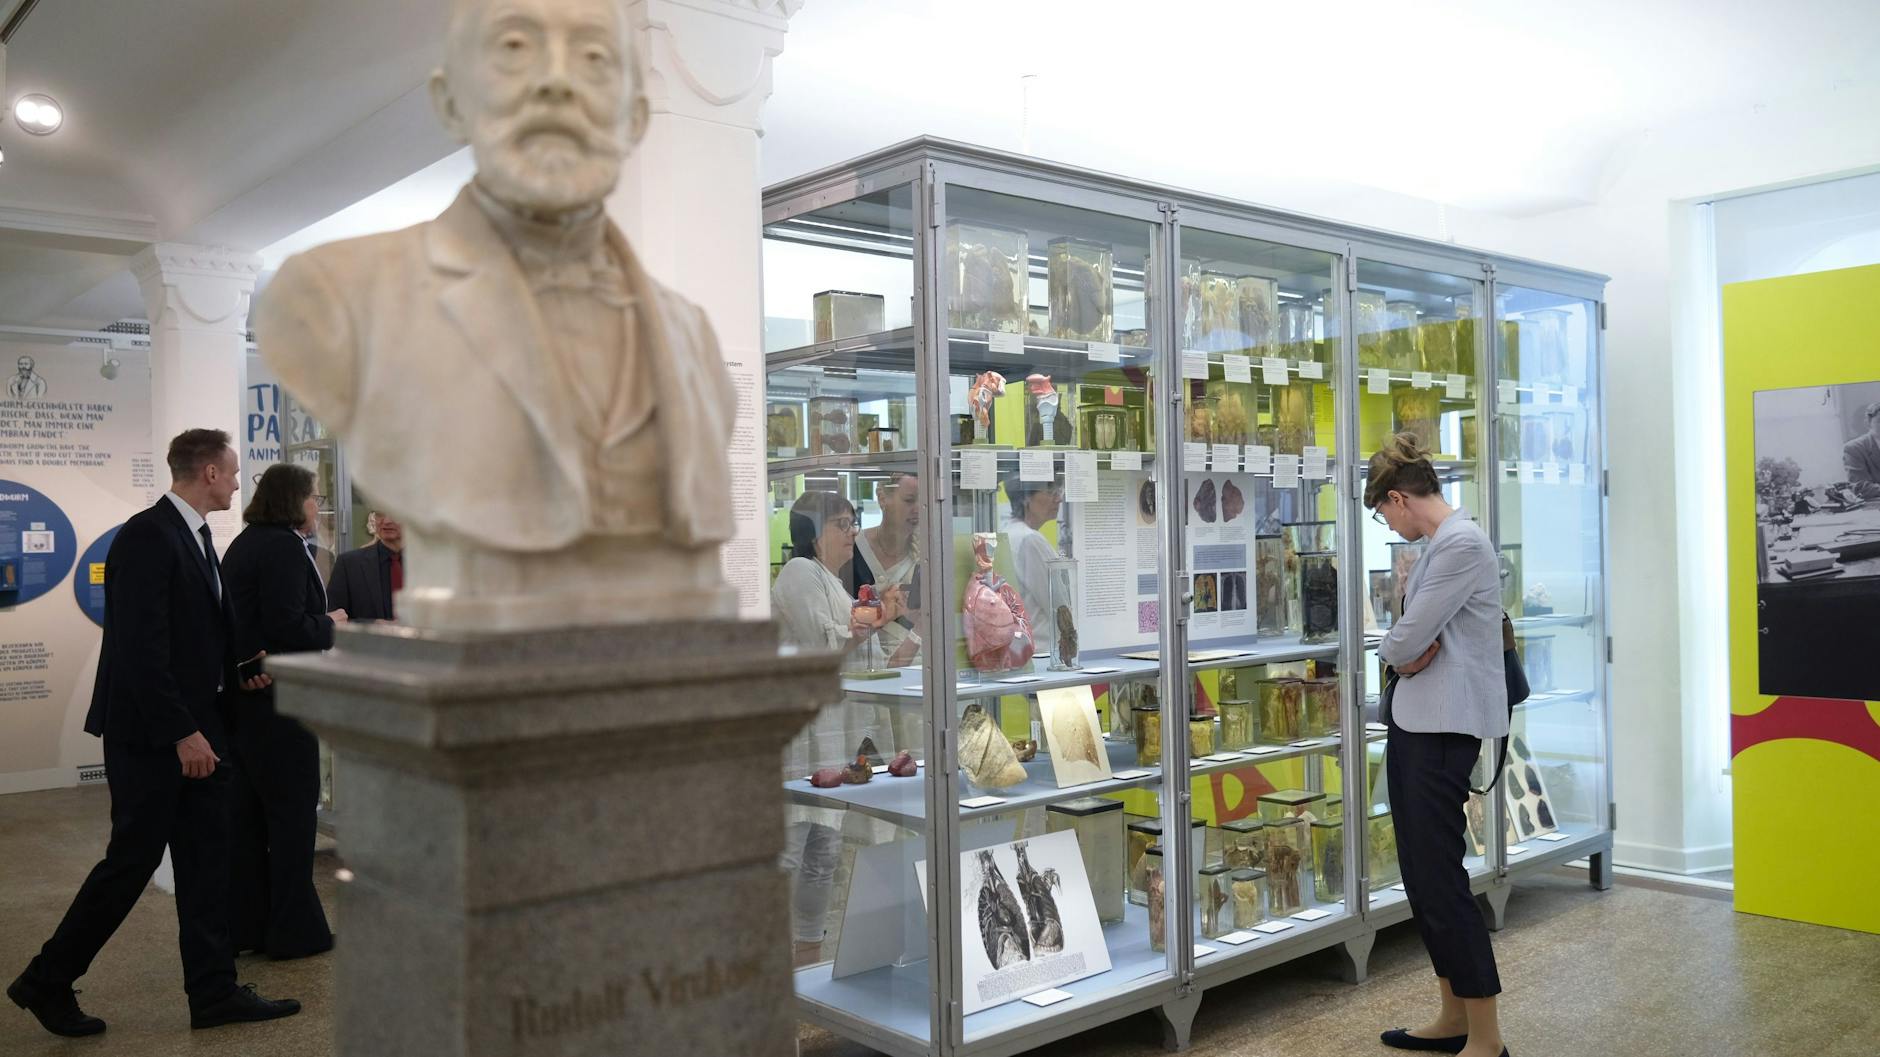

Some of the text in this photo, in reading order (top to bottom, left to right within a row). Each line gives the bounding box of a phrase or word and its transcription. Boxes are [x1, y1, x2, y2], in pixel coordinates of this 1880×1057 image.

[87, 403, 113, 412] HABEN
[60, 412, 83, 420] WENN
[86, 413, 104, 421] MAN
[24, 420, 42, 429] MAN
[45, 421, 74, 430] IMMER
[77, 422, 95, 430] EINE
